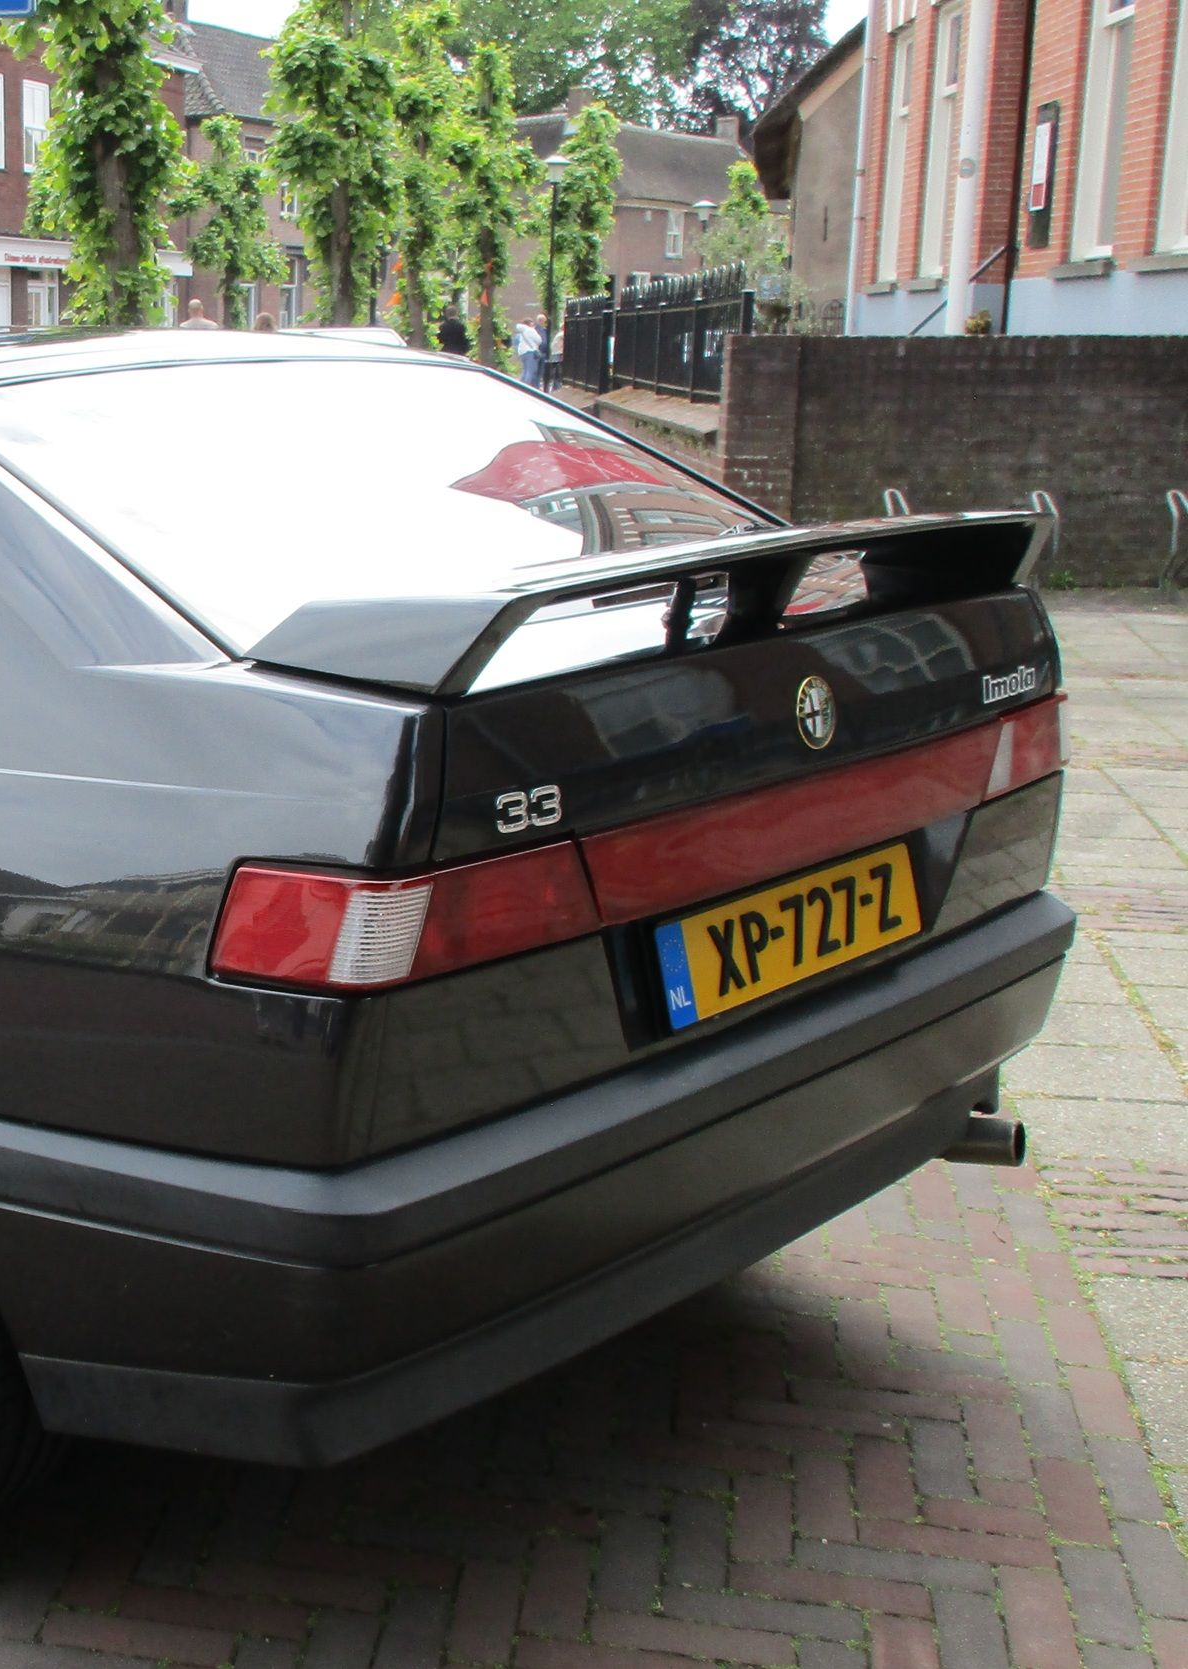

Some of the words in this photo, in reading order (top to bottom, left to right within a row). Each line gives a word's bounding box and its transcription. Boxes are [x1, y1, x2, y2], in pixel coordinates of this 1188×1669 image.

[983, 665, 1035, 704] Imola
[496, 784, 562, 834] 33
[707, 863, 902, 997] XP-727-Z
[669, 986, 692, 1011] NL
